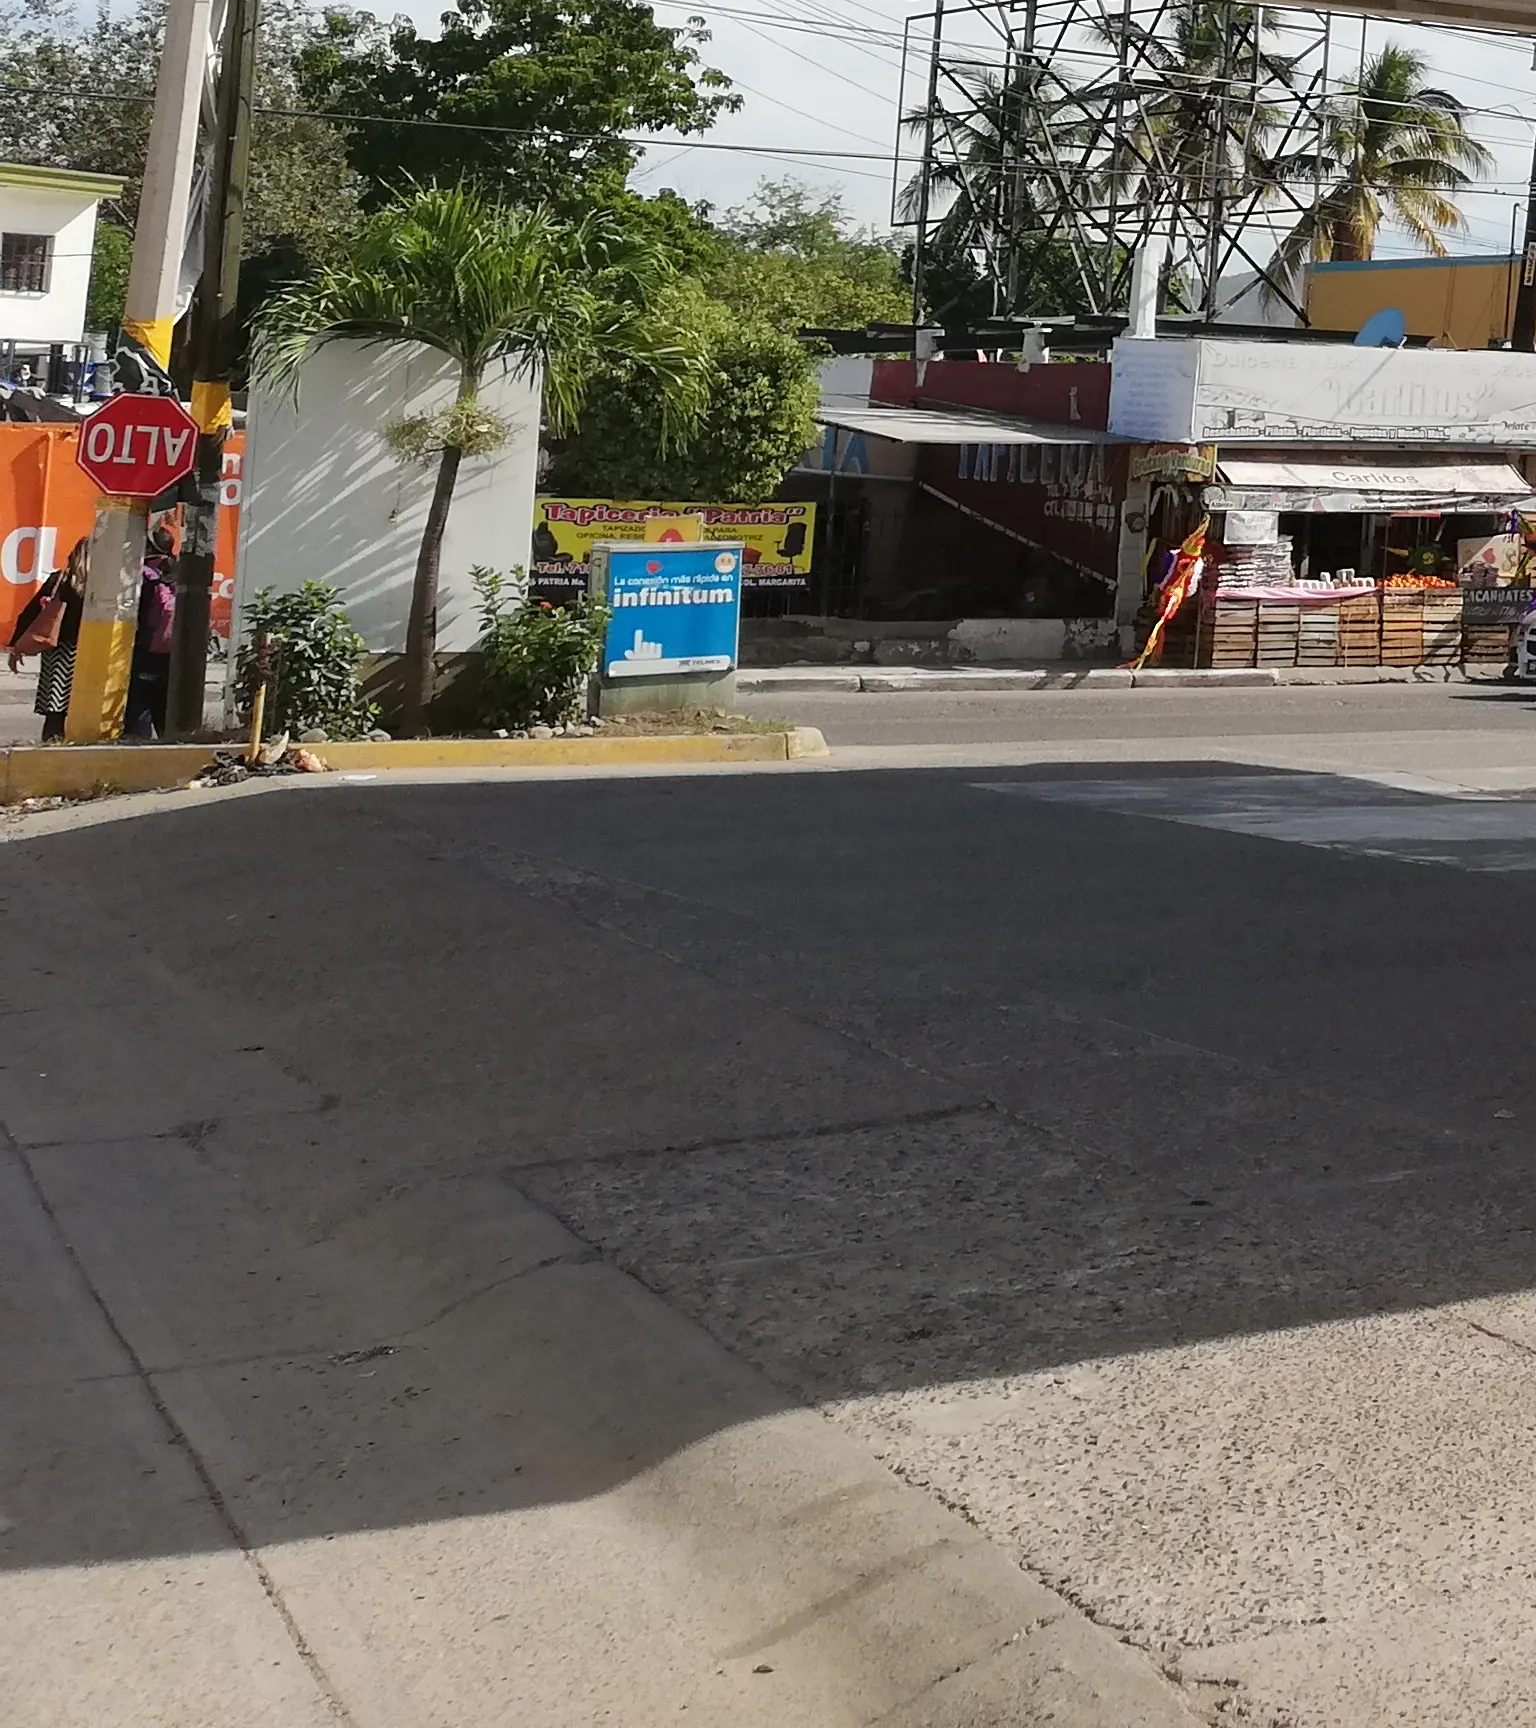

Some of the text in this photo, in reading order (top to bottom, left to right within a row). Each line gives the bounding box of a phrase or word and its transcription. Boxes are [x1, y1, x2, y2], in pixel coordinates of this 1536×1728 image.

[1203, 426, 1260, 438] Desechables
[86, 423, 190, 466] ALTO
[1332, 471, 1419, 485] Carlitos
[538, 577, 569, 586] PATRIA
[759, 577, 806, 586] MARGARITA
[614, 576, 625, 585] La
[613, 586, 733, 608] infinitum
